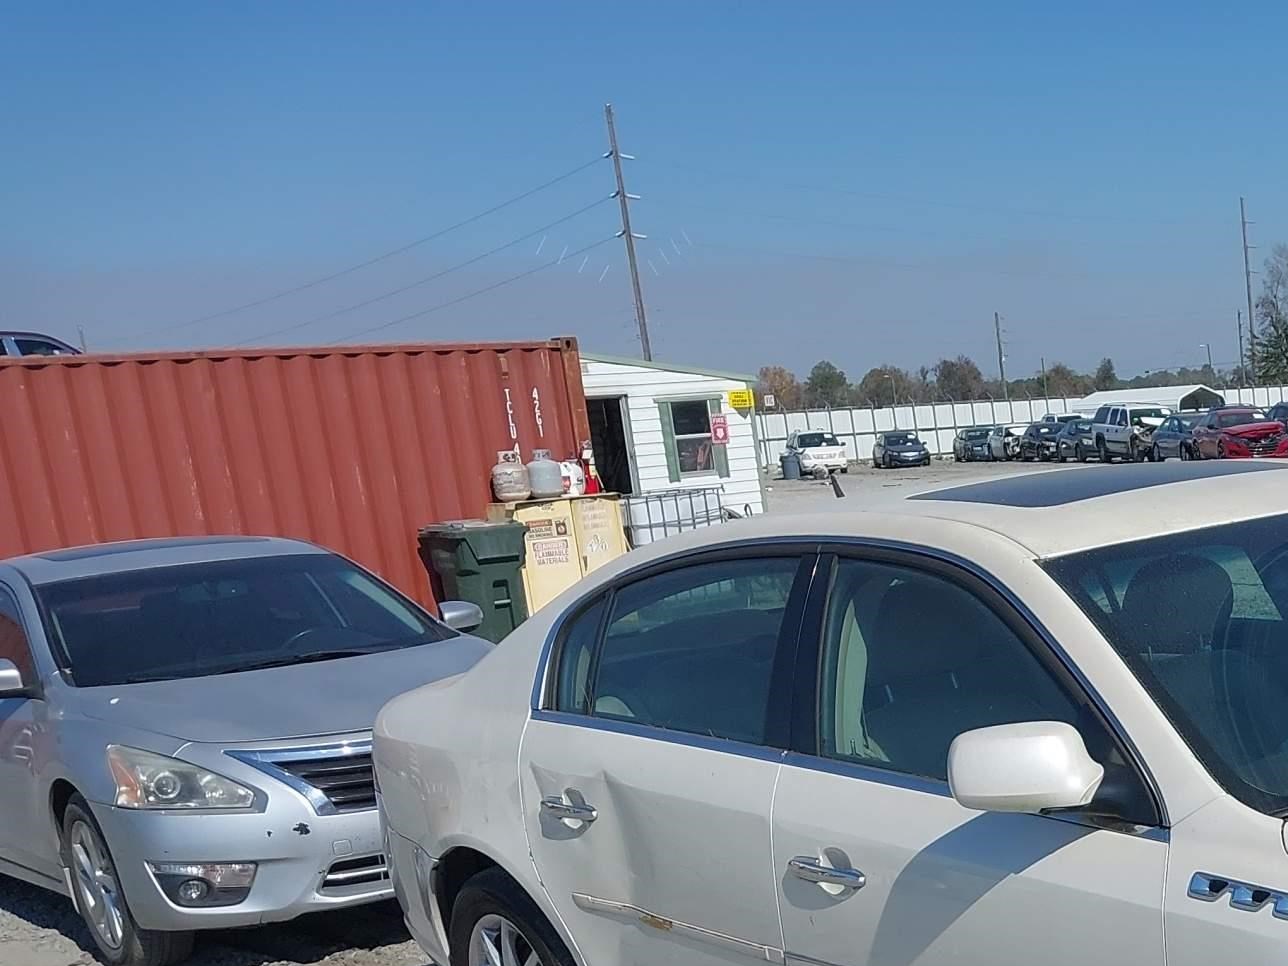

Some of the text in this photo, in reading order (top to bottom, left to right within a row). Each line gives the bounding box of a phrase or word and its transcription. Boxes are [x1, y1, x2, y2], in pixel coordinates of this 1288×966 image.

[504, 388, 517, 439] TCLU
[535, 549, 569, 558] FLAMMABLE
[537, 557, 569, 565] MATERIALS
